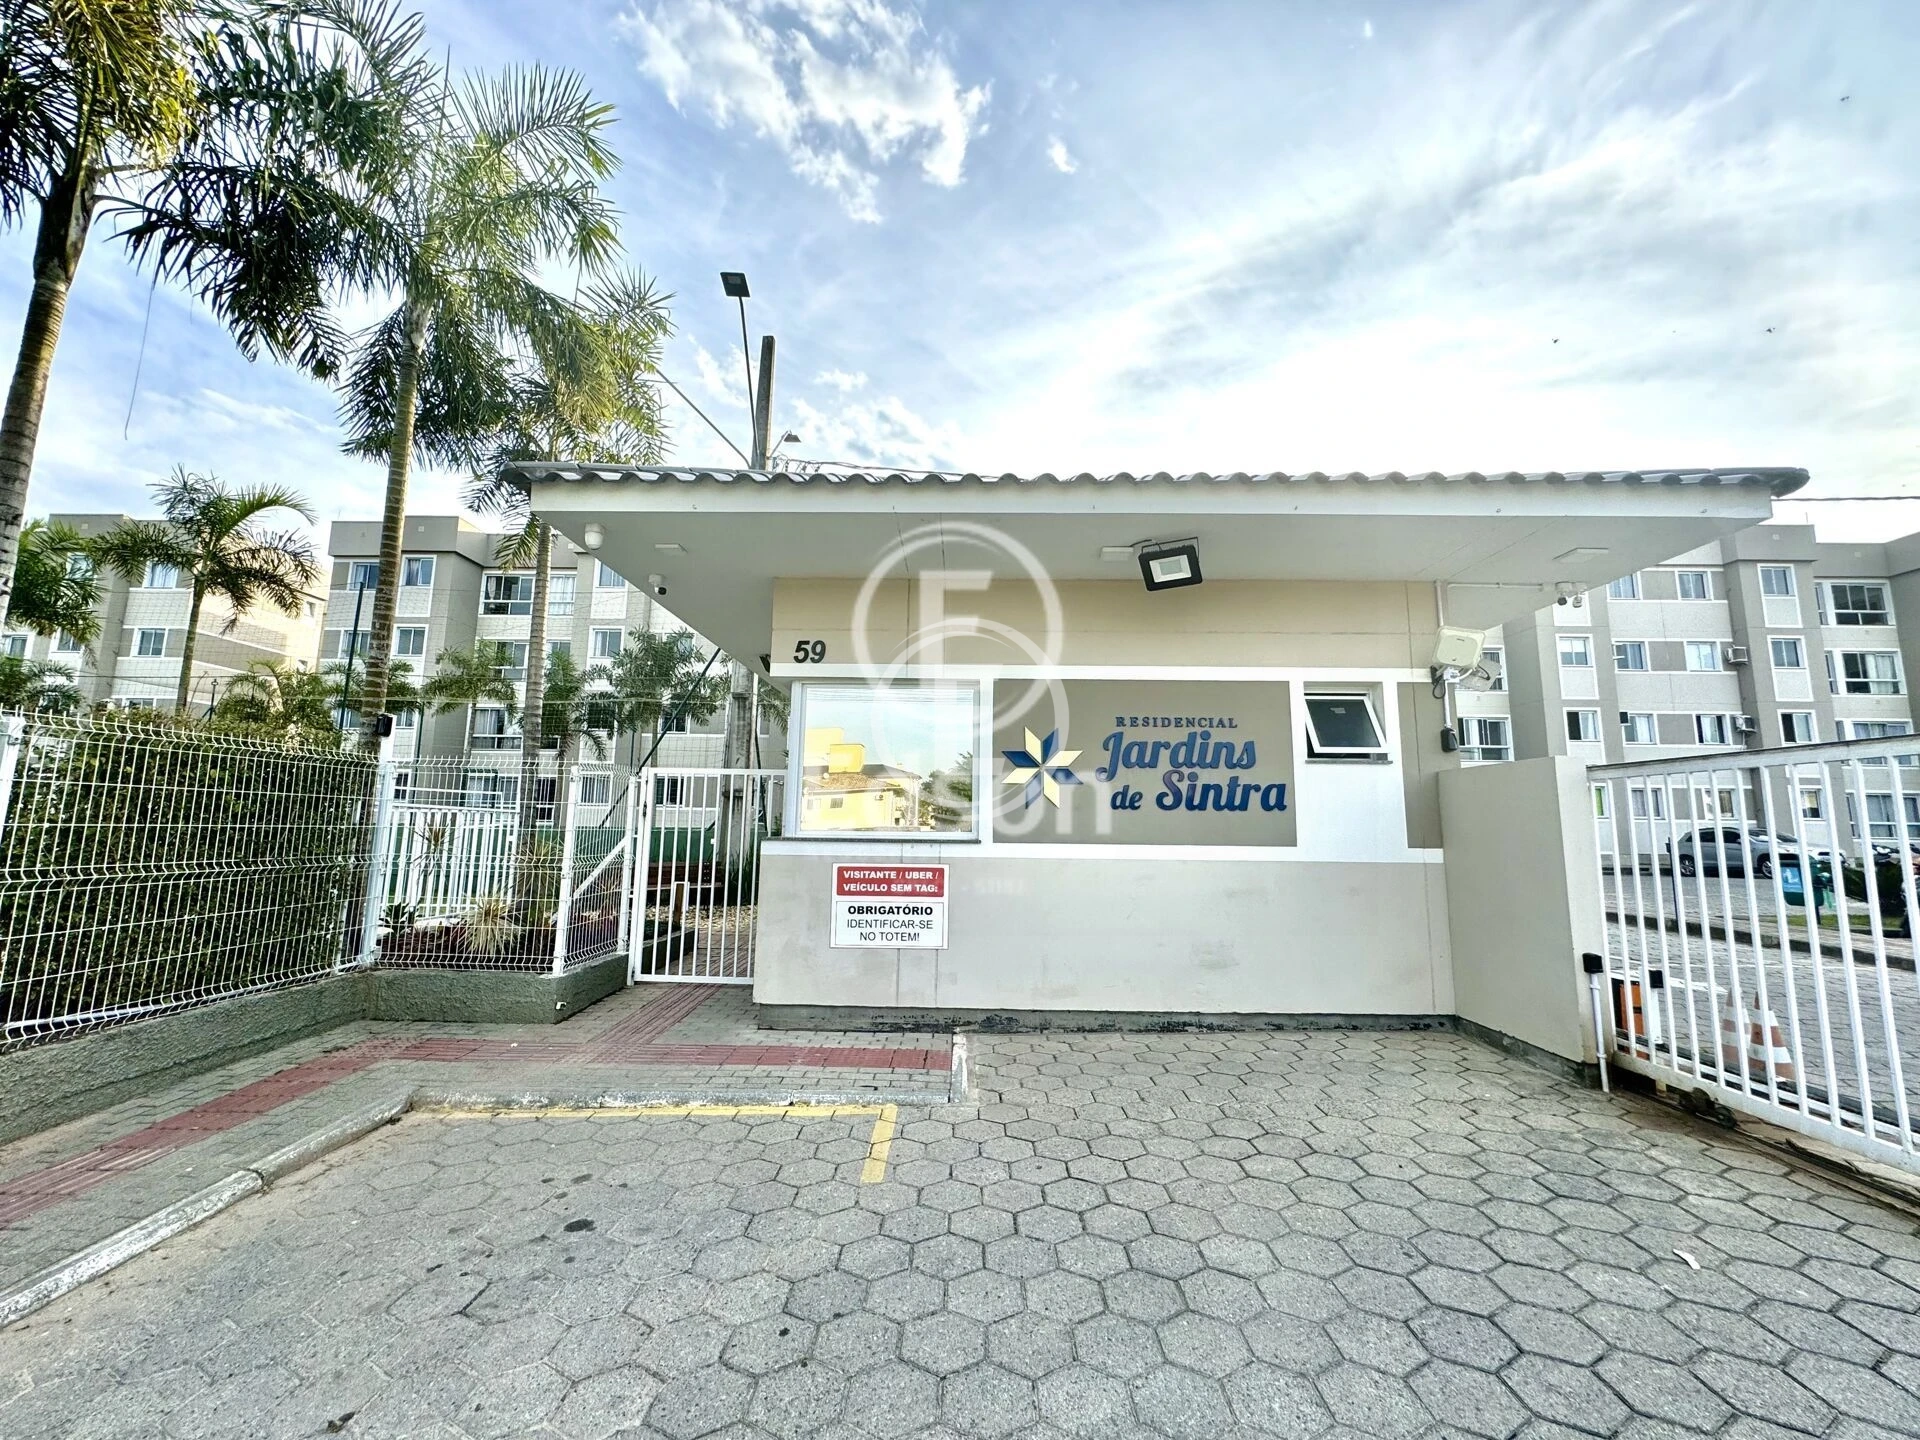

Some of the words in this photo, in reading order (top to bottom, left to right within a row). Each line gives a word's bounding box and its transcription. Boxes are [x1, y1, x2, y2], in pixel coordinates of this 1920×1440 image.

[793, 640, 826, 664] 59
[1115, 716, 1238, 729] RESIDENCIAL
[1095, 730, 1257, 782] Jardins
[1110, 784, 1144, 811] de
[1155, 769, 1288, 812] Sintra
[843, 870, 897, 879] VISITANTE
[905, 871, 933, 880] UBER
[843, 882, 888, 892] VEÍCULO
[890, 884, 912, 892] SEM
[914, 884, 938, 893] TAG:
[847, 904, 933, 916] OBRIGATÓRIO
[847, 919, 933, 929] IDENTIFICAR-SE
[859, 932, 876, 941] NO
[879, 932, 920, 942] TOTEM!
